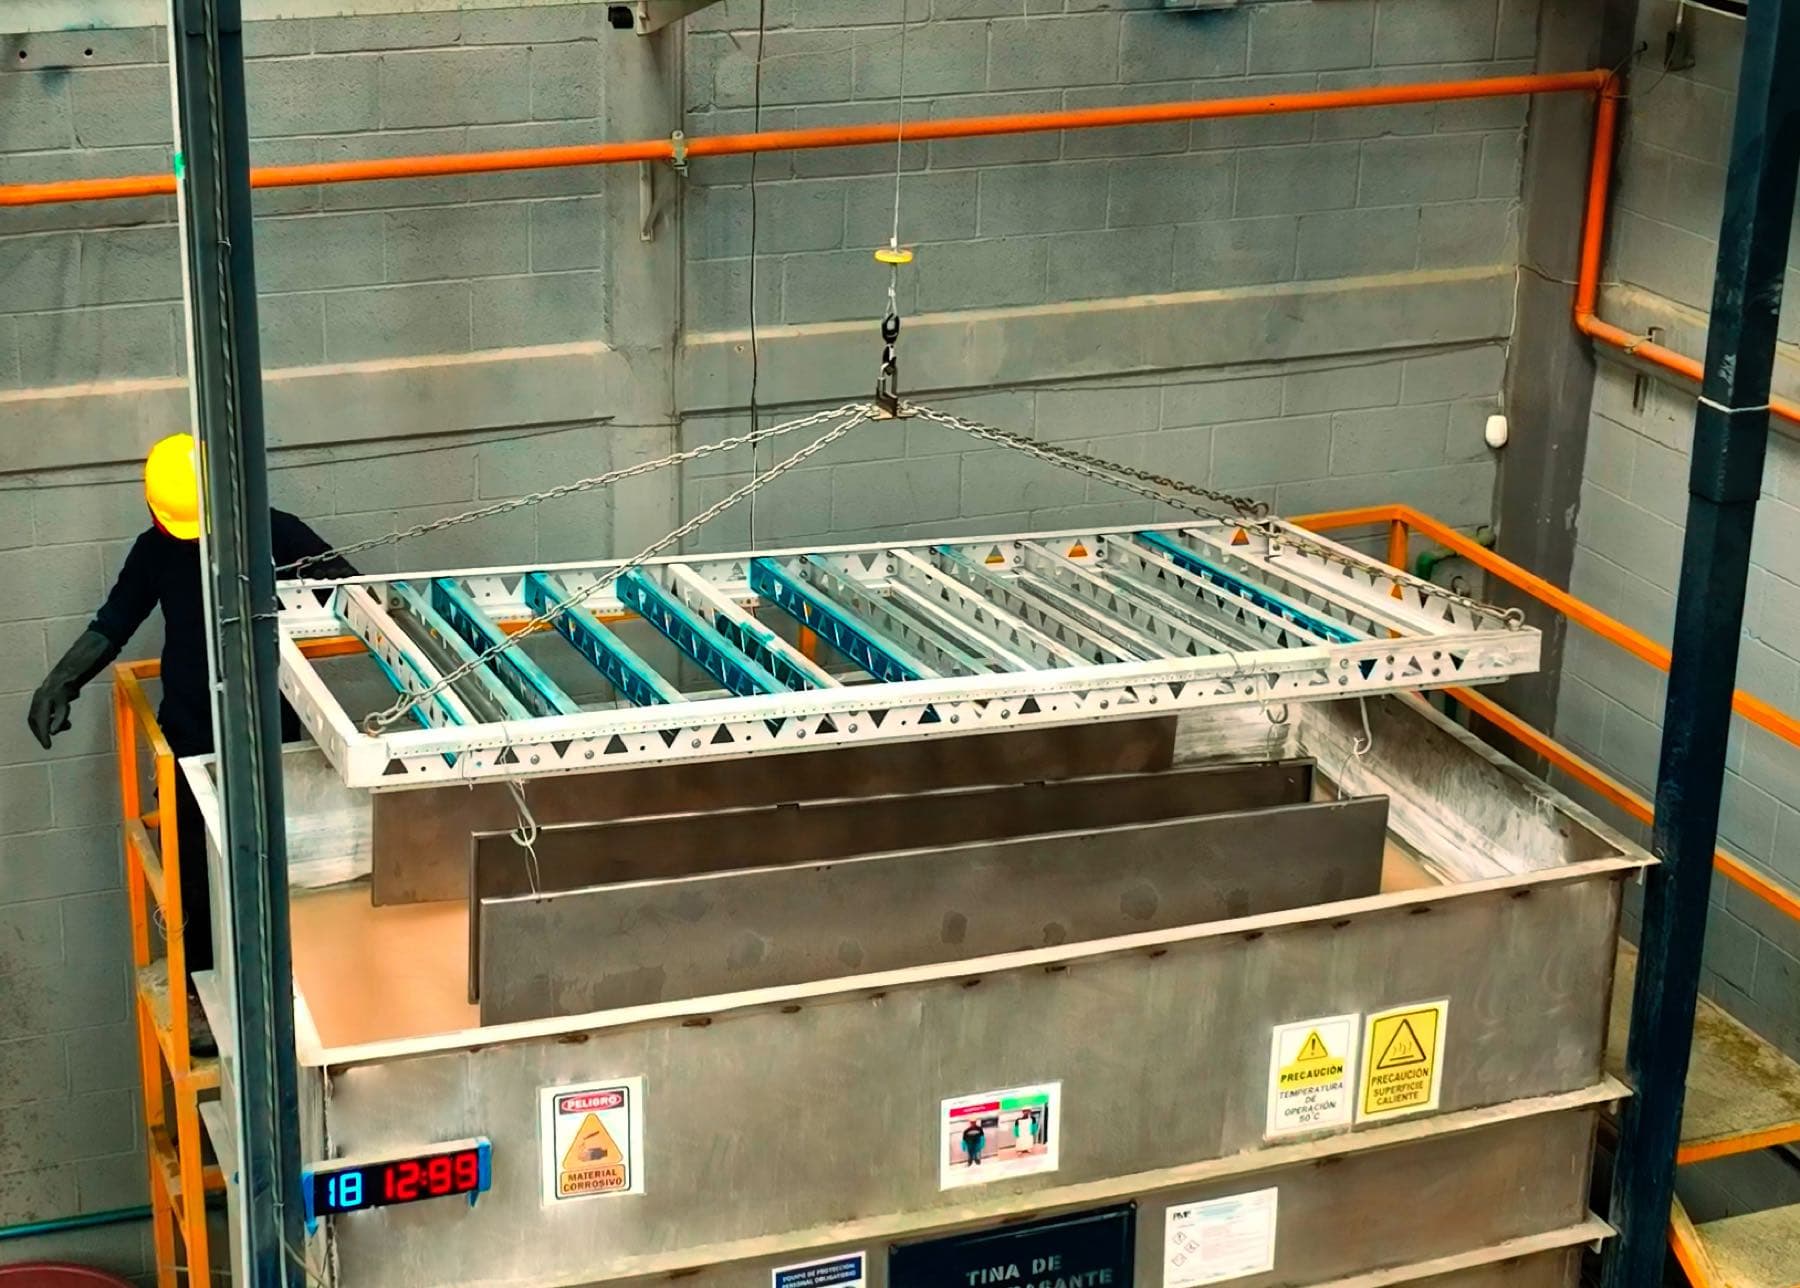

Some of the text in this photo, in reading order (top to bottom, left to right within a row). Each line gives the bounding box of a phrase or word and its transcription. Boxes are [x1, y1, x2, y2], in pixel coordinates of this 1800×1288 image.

[1280, 1082, 1343, 1099] TEMPERATURA
[1374, 1081, 1423, 1097] SUPERFICIE
[567, 1095, 617, 1109] PELIGRO
[1305, 1095, 1316, 1103] DE
[1376, 1091, 1419, 1106] CALIENTE
[568, 1168, 617, 1181] MATERIAL
[328, 1171, 363, 1207] 18
[563, 1177, 622, 1192] CORROSIVO
[966, 1255, 1062, 1286] TINA DE
